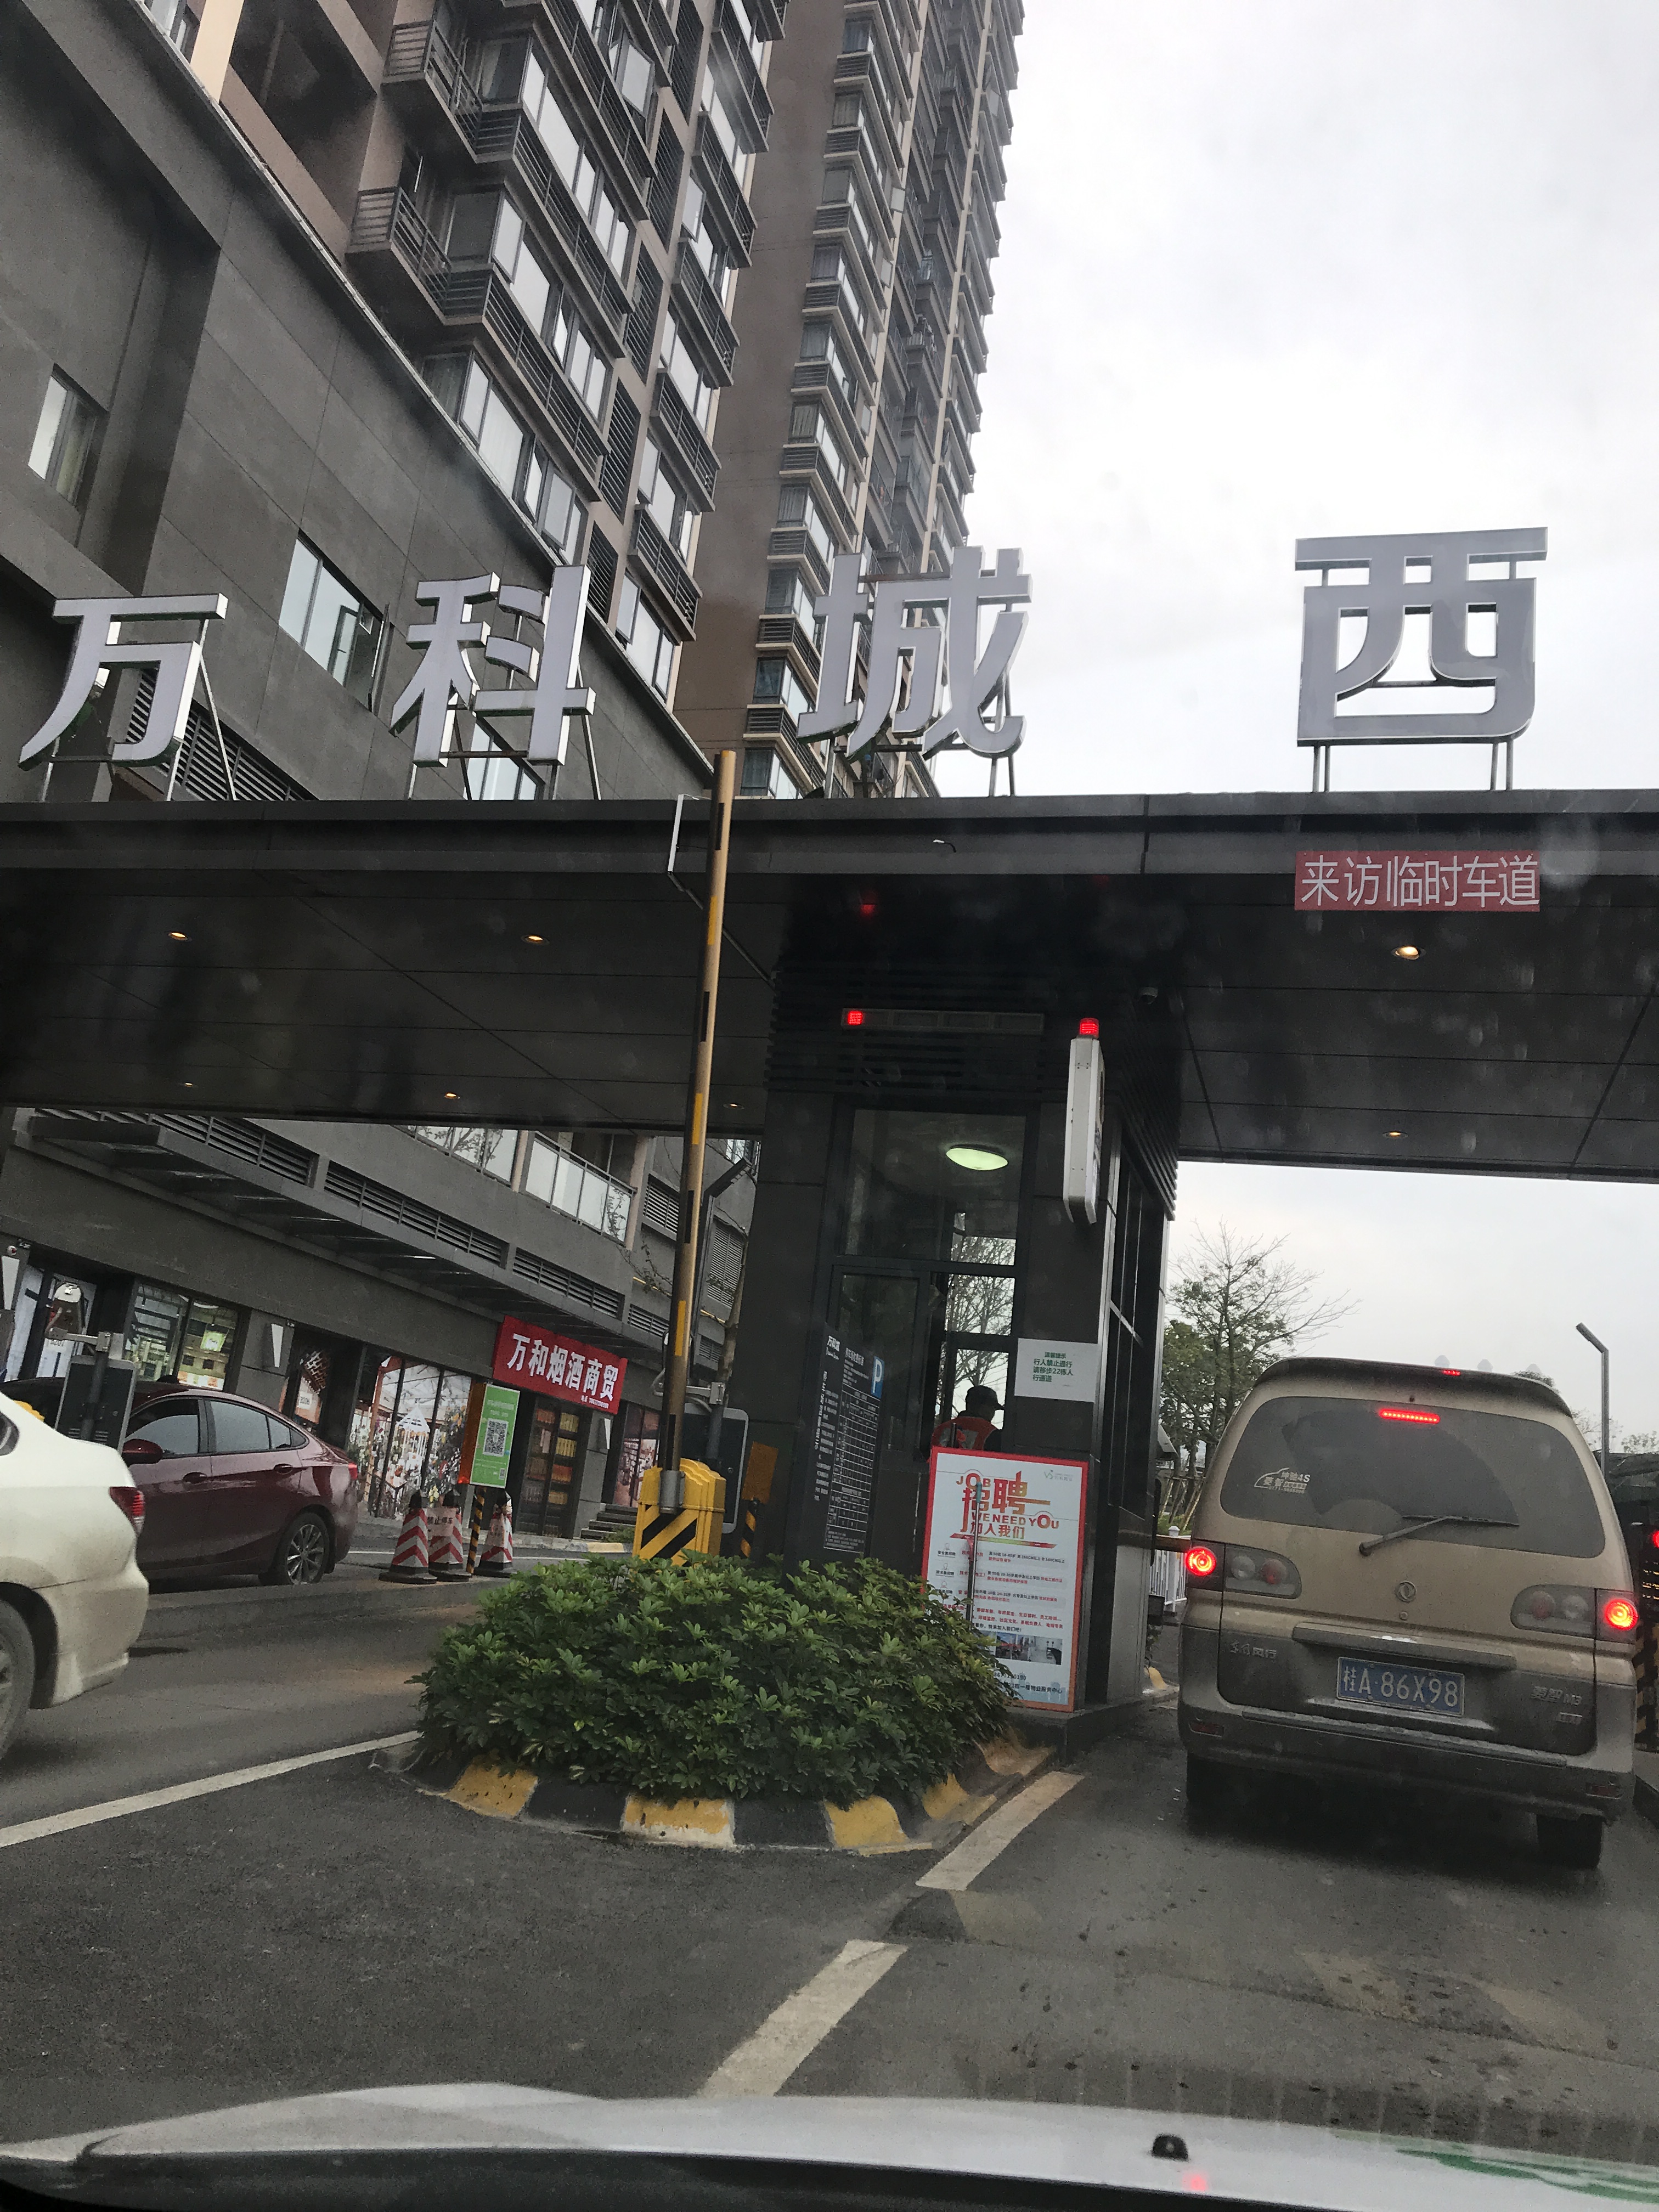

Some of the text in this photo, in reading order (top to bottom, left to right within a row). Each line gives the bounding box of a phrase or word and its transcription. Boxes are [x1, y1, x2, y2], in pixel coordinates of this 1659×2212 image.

[1301, 854, 1540, 908] 来访临时车道
[506, 1333, 619, 1402] 万和烟酒商贸
[872, 1358, 883, 1394] P
[1033, 1358, 1073, 1368] 行人禁止通行
[960, 1470, 1051, 1533] 招聘
[970, 1521, 1025, 1539] 加入我们
[992, 1514, 1026, 1526] NEED
[1029, 1514, 1060, 1530] YOU
